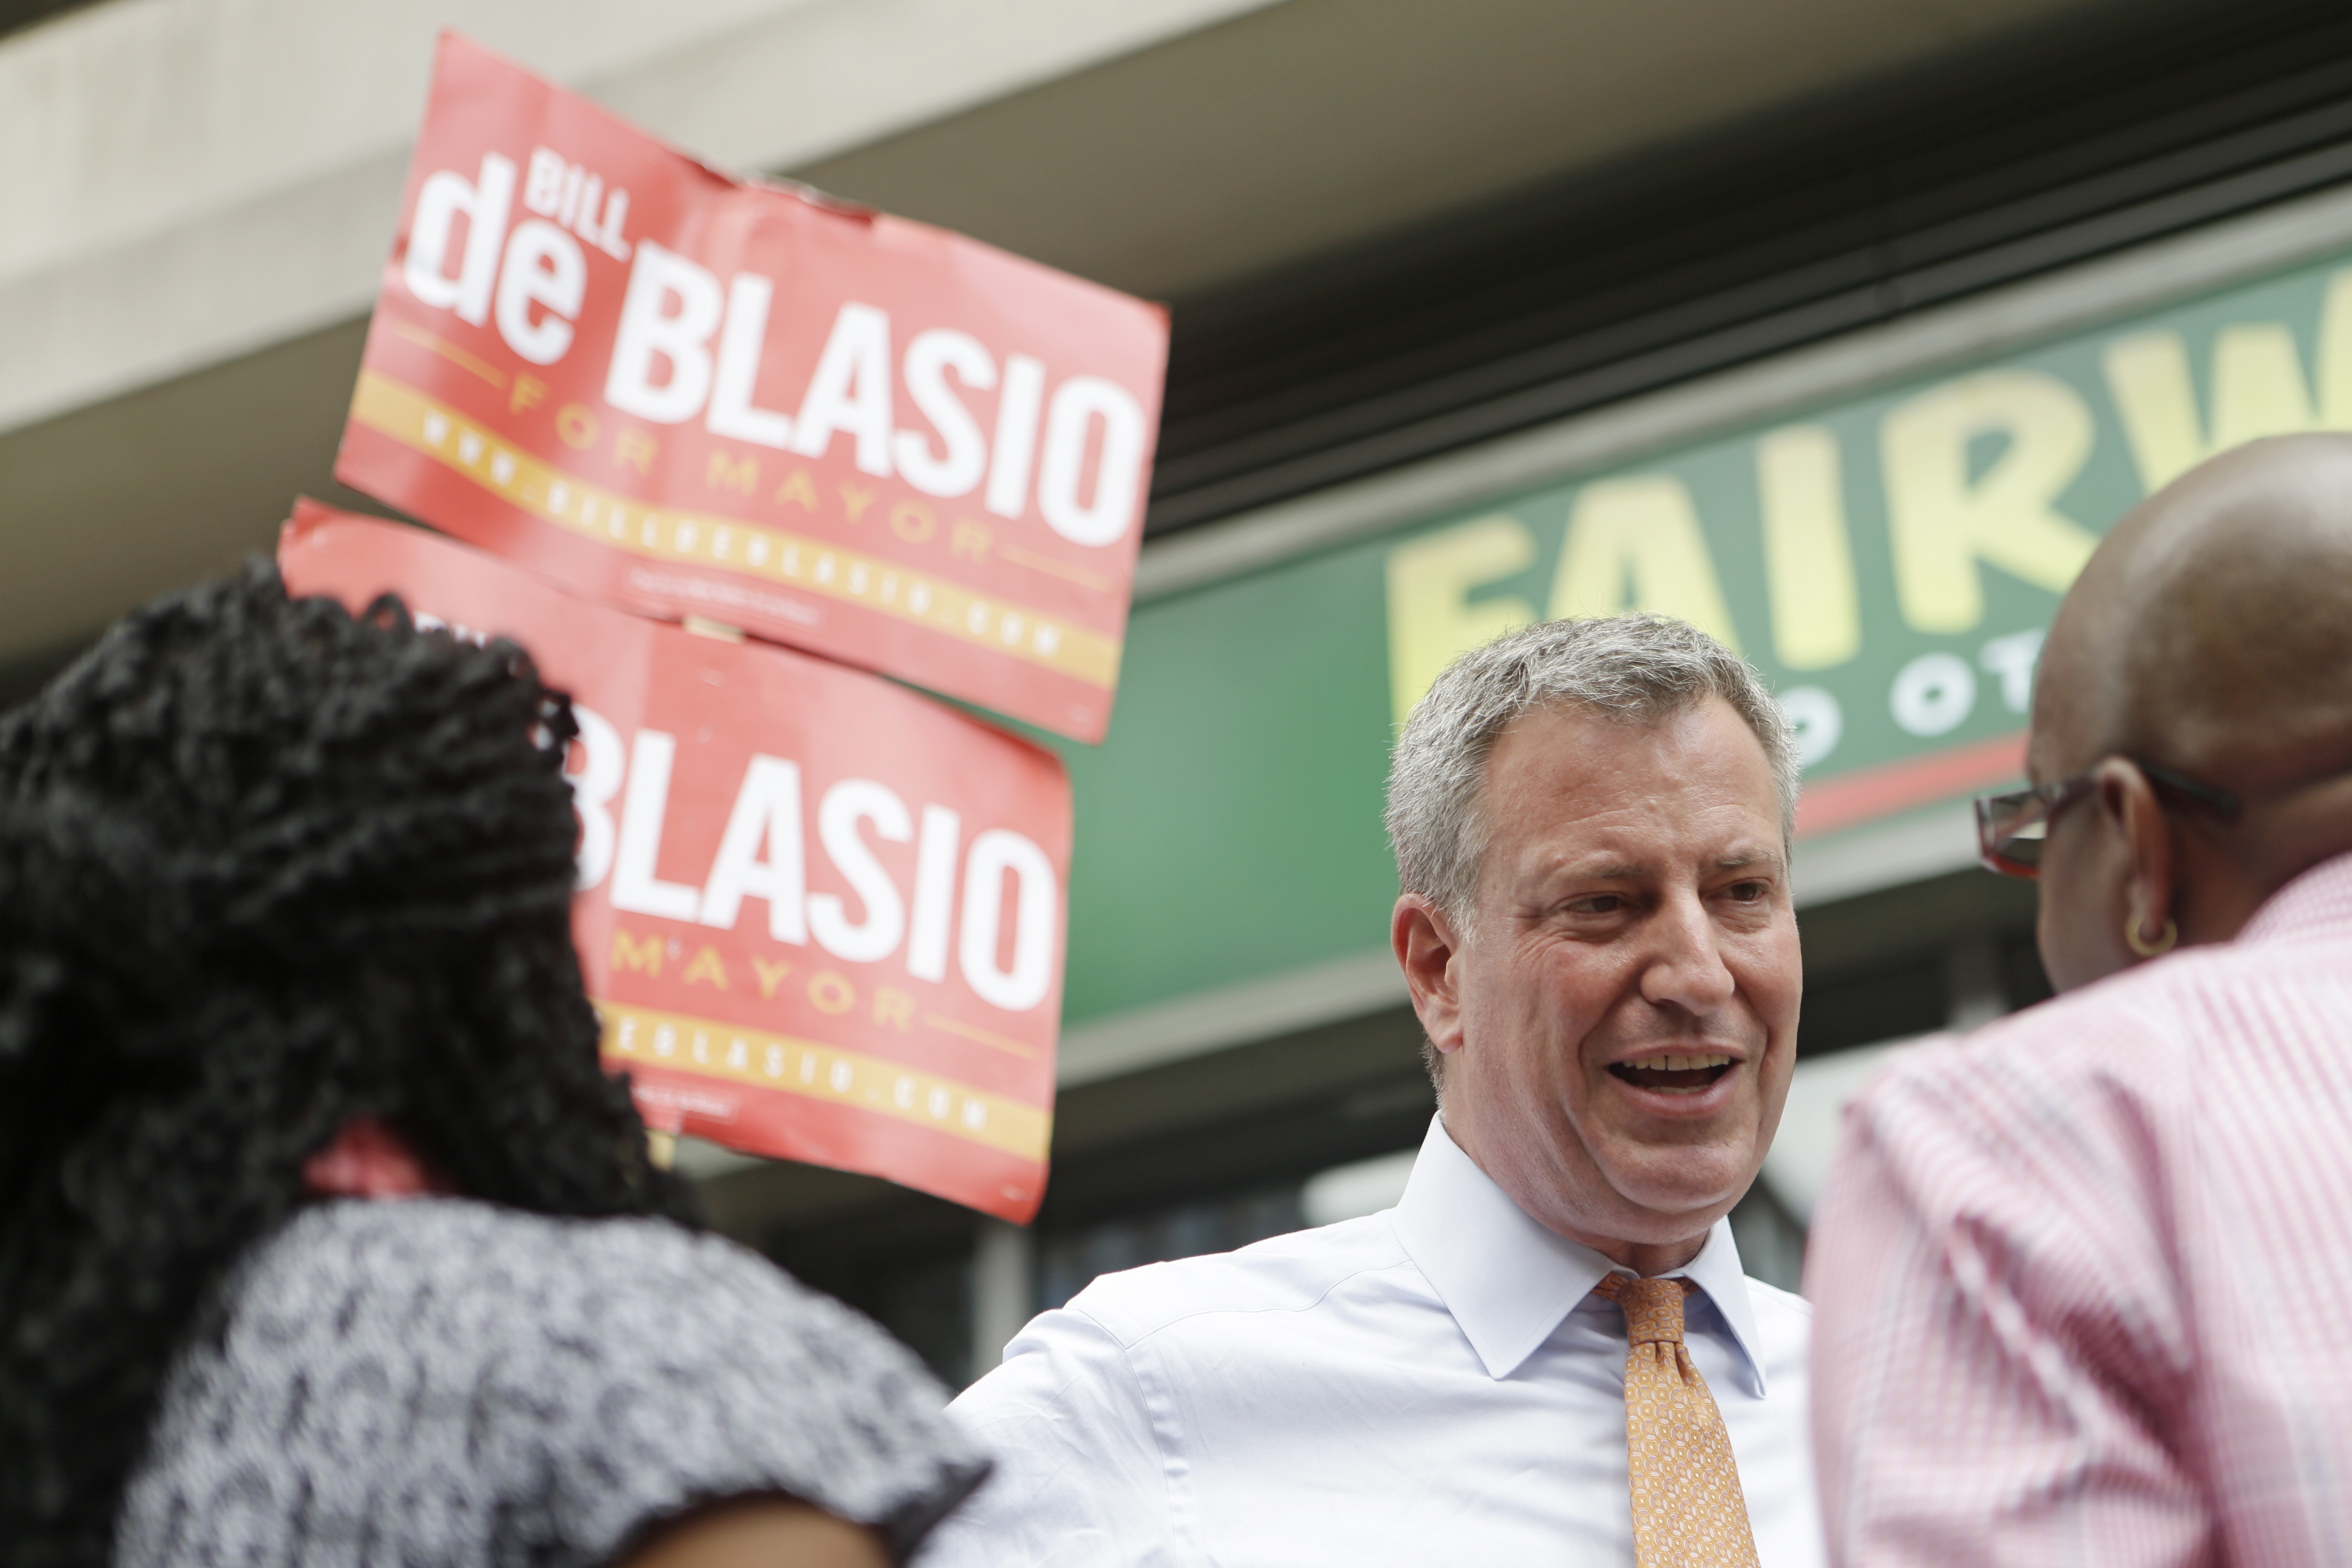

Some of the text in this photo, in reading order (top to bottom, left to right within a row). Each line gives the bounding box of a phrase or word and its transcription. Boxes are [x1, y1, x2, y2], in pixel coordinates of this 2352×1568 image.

[522, 144, 633, 264] BILL
[403, 150, 1147, 547] de BLASIO
[508, 370, 995, 565] FOR MAYOR
[609, 928, 916, 1036] MAYOR
